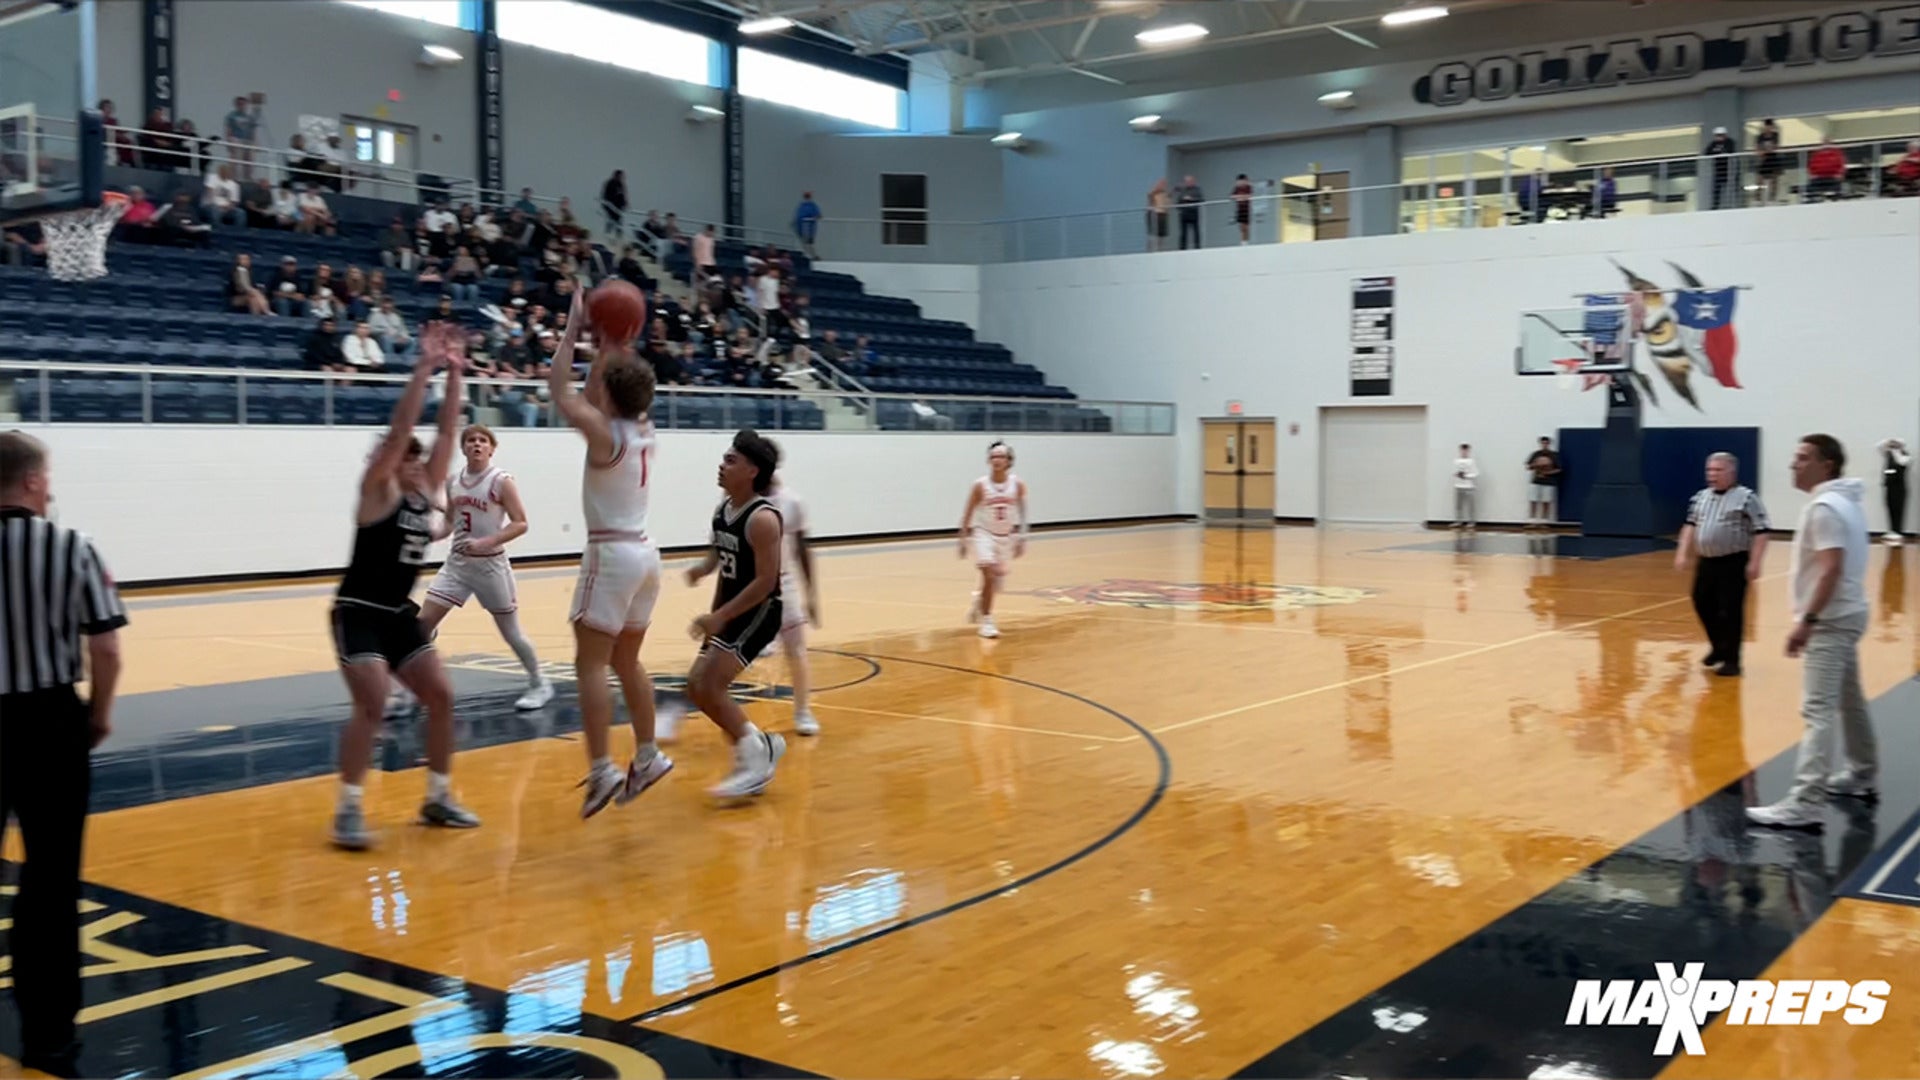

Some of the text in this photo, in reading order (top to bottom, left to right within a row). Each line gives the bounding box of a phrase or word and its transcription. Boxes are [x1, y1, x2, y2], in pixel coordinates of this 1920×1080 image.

[1429, 31, 1704, 107] GOLIAD
[640, 447, 648, 487] 1
[460, 511, 472, 533] 3
[716, 552, 737, 579] 23
